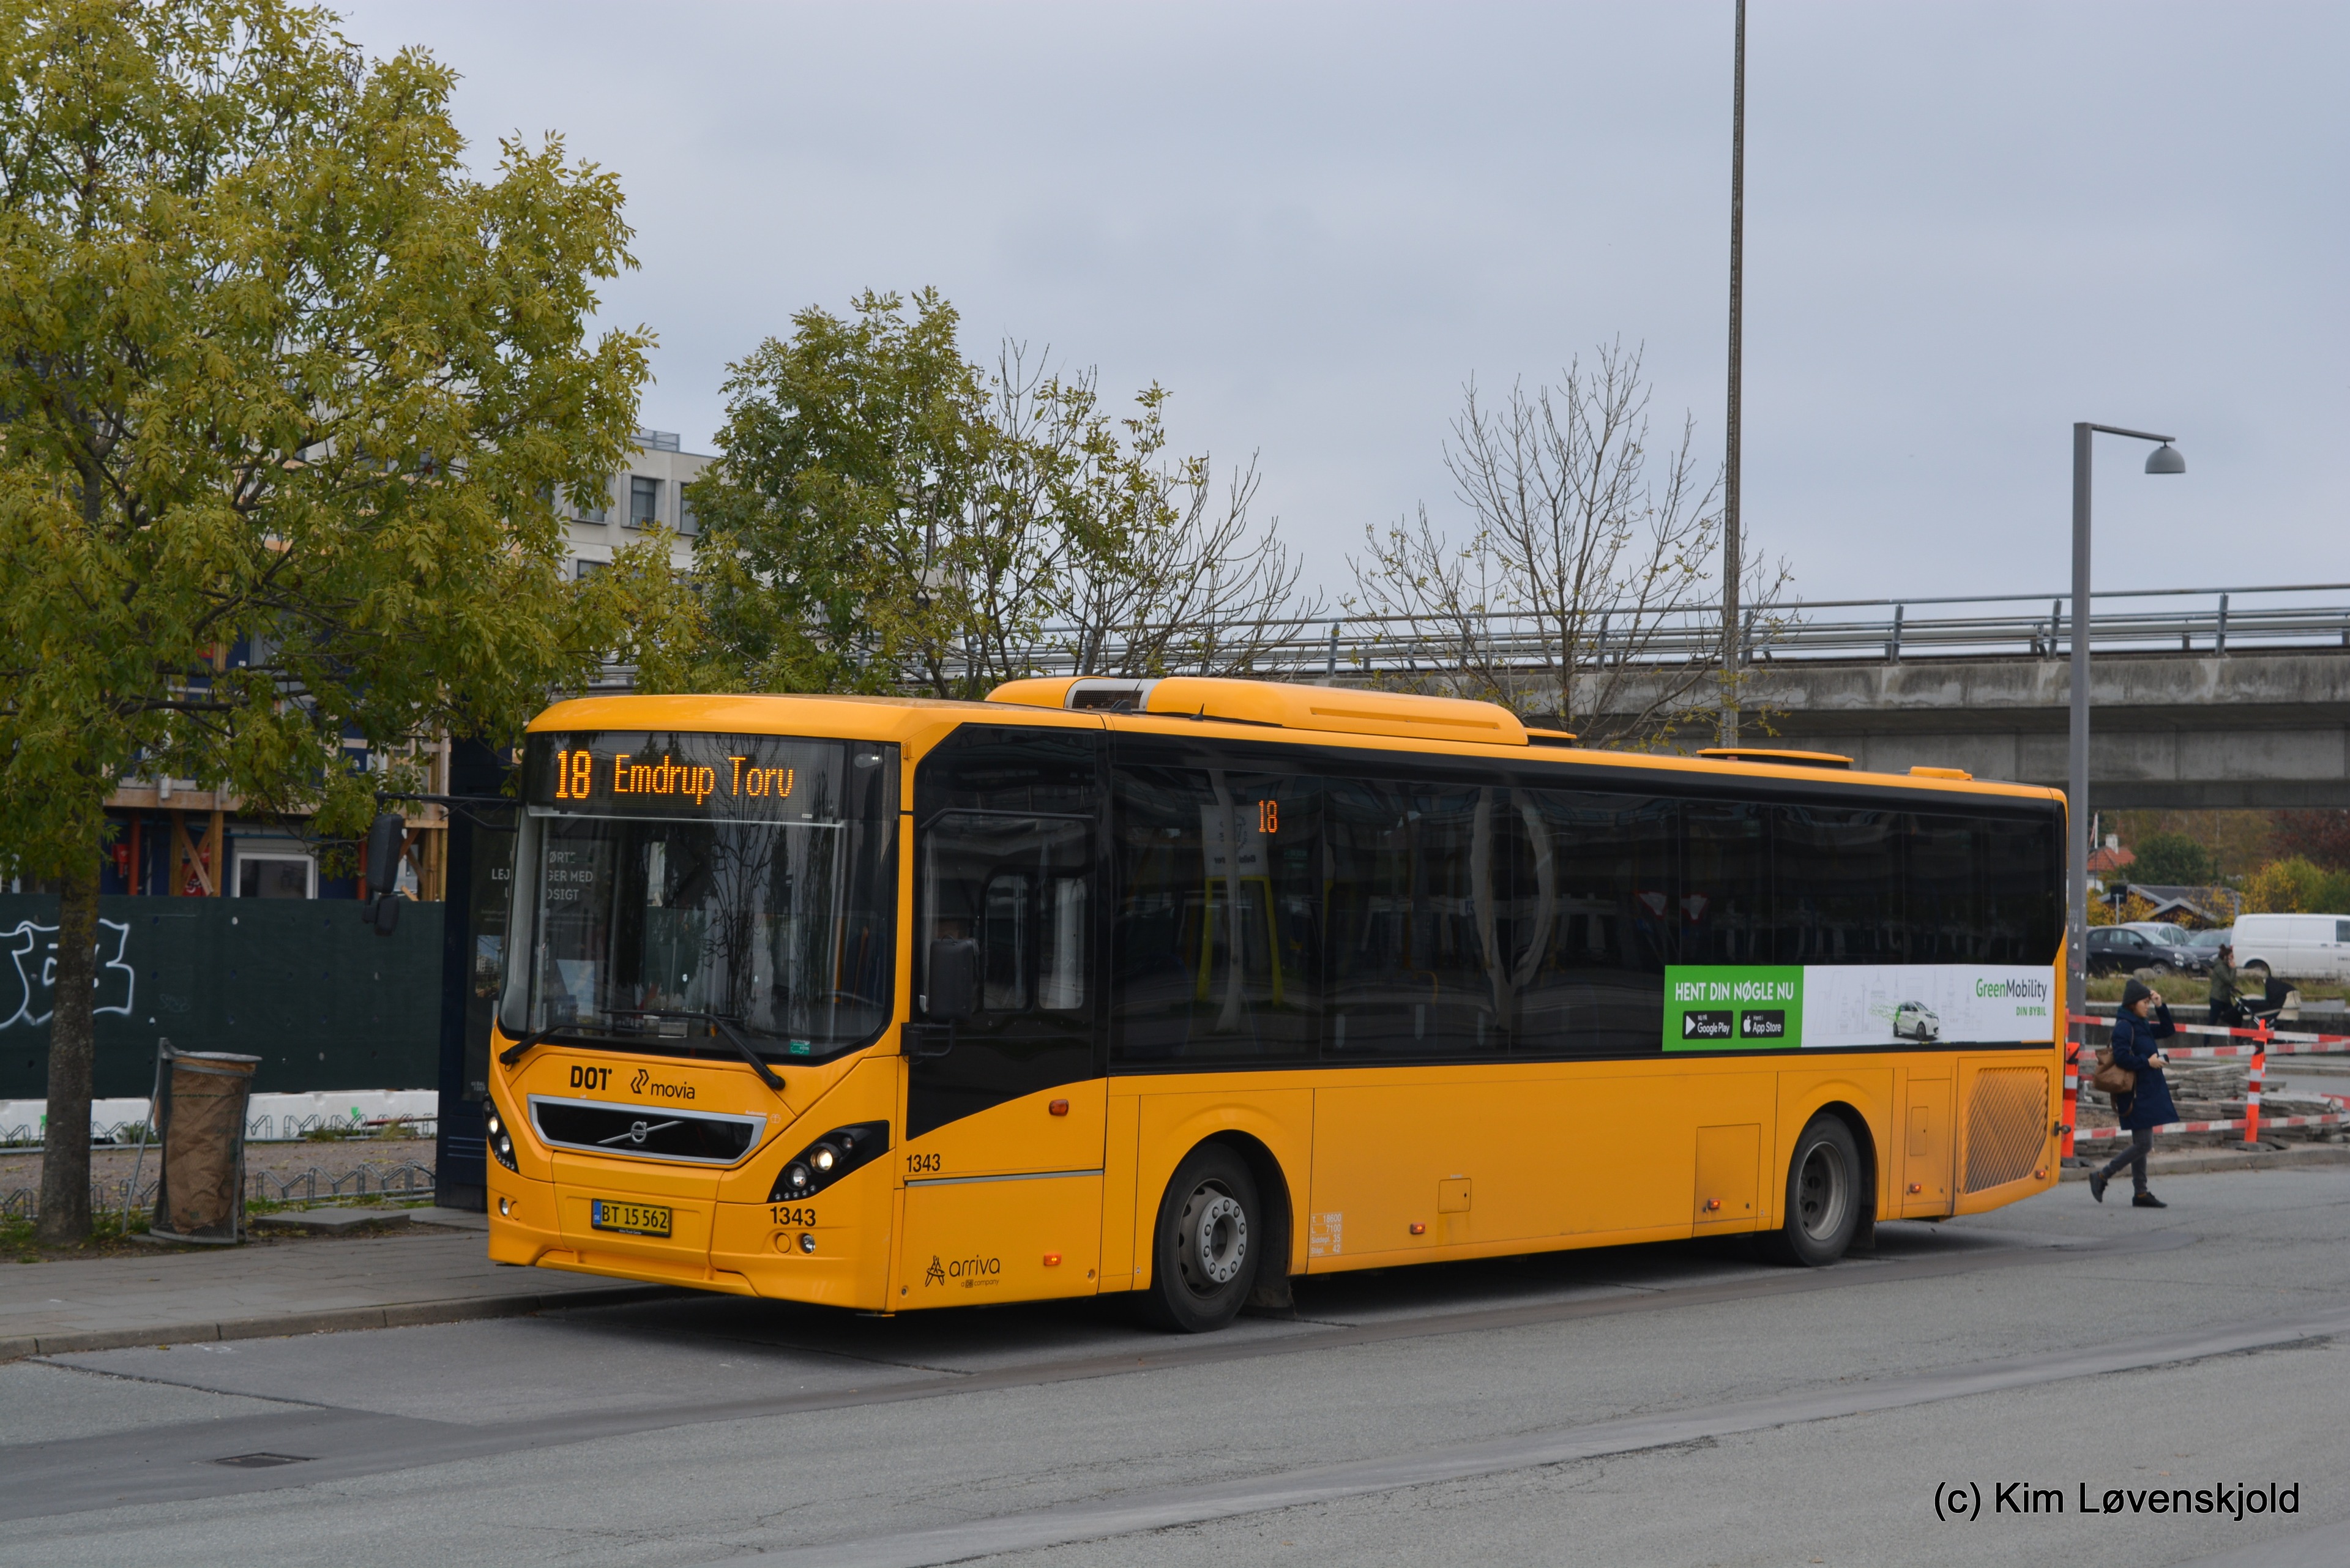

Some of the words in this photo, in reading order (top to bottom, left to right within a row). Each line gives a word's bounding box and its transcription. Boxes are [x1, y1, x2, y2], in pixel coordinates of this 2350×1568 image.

[556, 750, 591, 799] 18
[614, 754, 715, 805] Emdrup
[728, 756, 794, 797] Torv
[1258, 800, 1277, 833] 18
[570, 870, 593, 883] MED
[1675, 982, 1706, 1001] HENT
[1710, 982, 1730, 1001] DIN
[1734, 980, 1774, 1002] NØGLE
[1777, 982, 1794, 1000] NU
[1976, 978, 2047, 1002] GreenMobility
[2016, 1006, 2027, 1016] DIN
[2029, 1006, 2046, 1016] BYBIL
[1697, 1022, 1718, 1036] Google
[1718, 1023, 1730, 1035] Play
[1753, 1022, 1765, 1034] App
[1766, 1021, 1781, 1032] Store
[651, 1081, 695, 1100] movia
[906, 1153, 941, 1173] 1343
[602, 1205, 619, 1223] BT
[625, 1208, 638, 1225] 15
[643, 1210, 667, 1229] 562
[770, 1206, 816, 1227] 1343
[1323, 1214, 1341, 1223] 18600
[1326, 1224, 1341, 1233] 7100
[1333, 1234, 1340, 1242] 35
[1332, 1244, 1340, 1253] 42
[949, 1255, 1000, 1277] arriva
